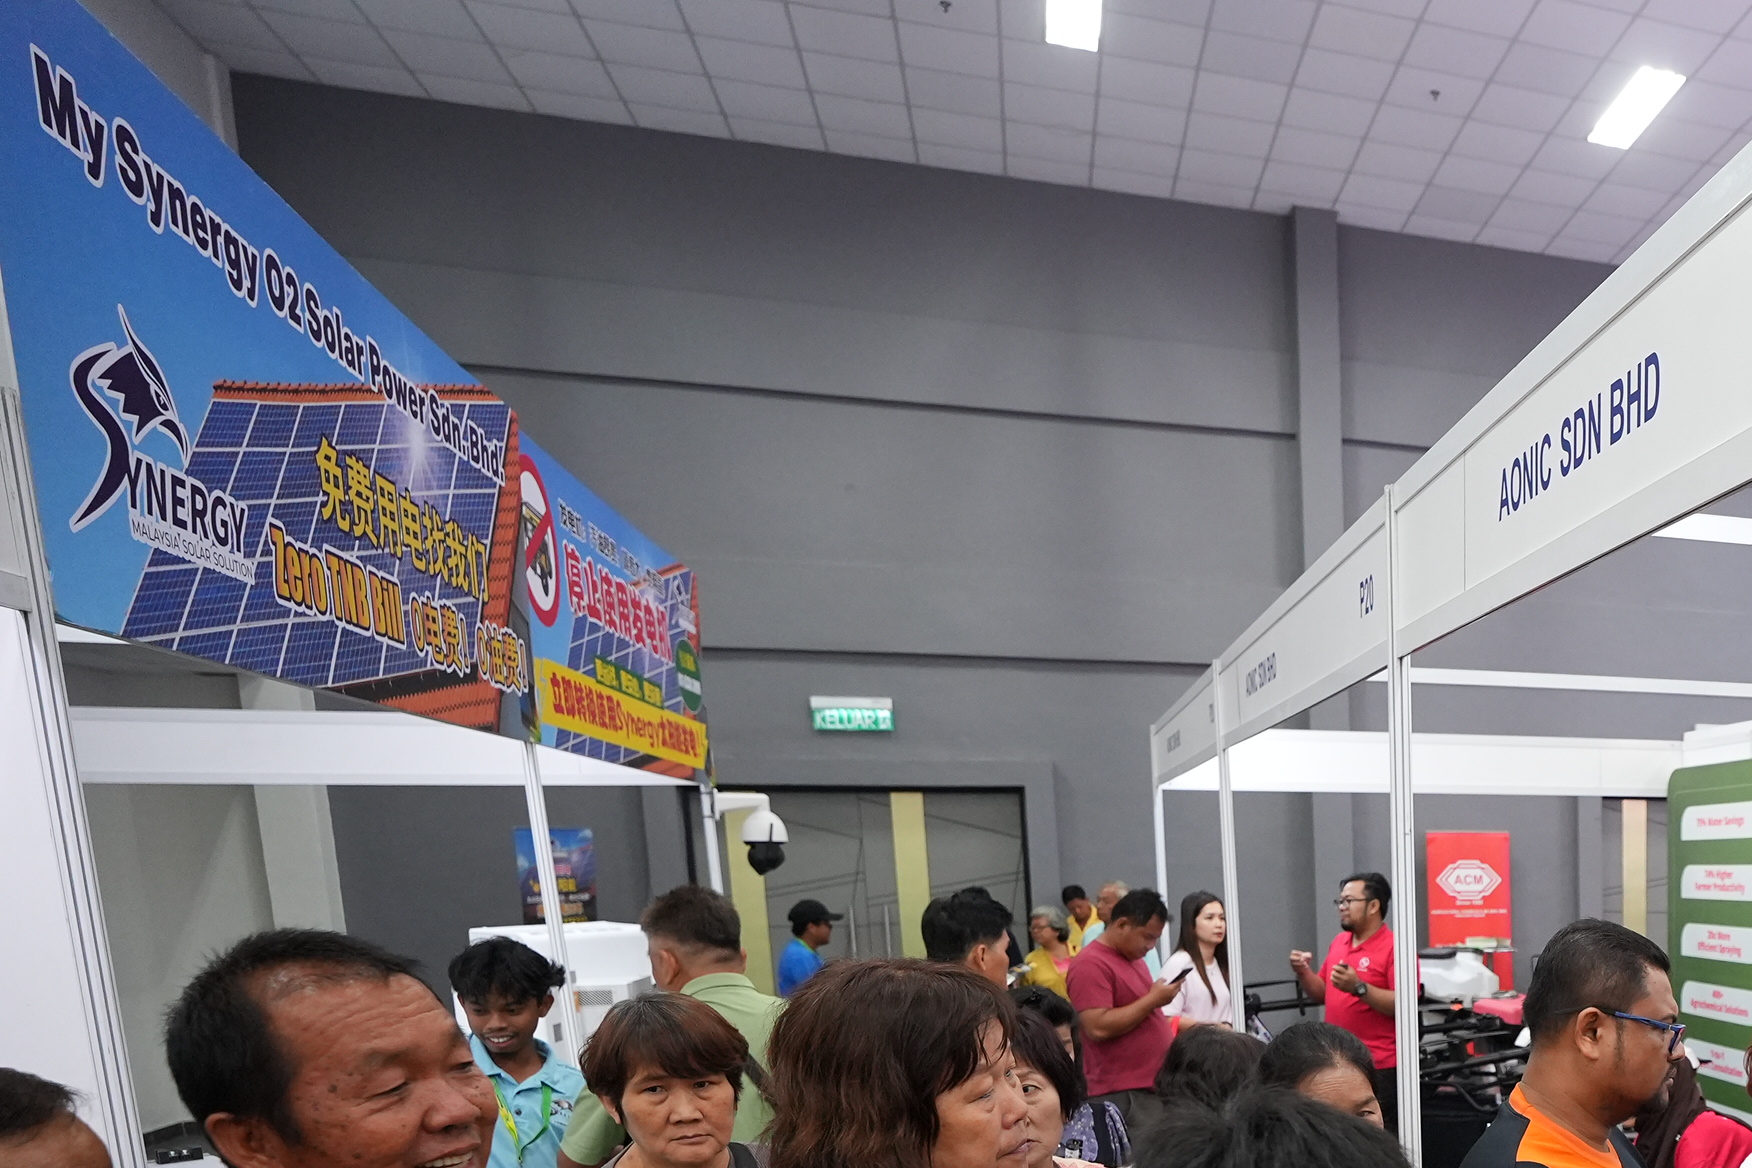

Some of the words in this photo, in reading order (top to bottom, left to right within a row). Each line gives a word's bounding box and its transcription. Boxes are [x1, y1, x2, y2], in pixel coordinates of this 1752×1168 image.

[32, 49, 106, 183] My
[114, 122, 260, 304] Synergy
[304, 287, 365, 379] Solar
[367, 339, 426, 424] Power
[1499, 432, 1552, 522] AONIC
[1560, 392, 1602, 478] SDN
[1609, 351, 1661, 447] BHD
[132, 518, 180, 551] MALAYSIA
[182, 540, 212, 564] SOLAR
[213, 551, 254, 579] SOLUTION
[314, 435, 490, 603] 免费用电找我们
[269, 524, 328, 616] Zero
[324, 550, 372, 632] TNB
[369, 571, 406, 646] Bill
[1359, 574, 1374, 619] P20
[815, 708, 877, 730] KELUAR
[1454, 874, 1484, 886] ACM
